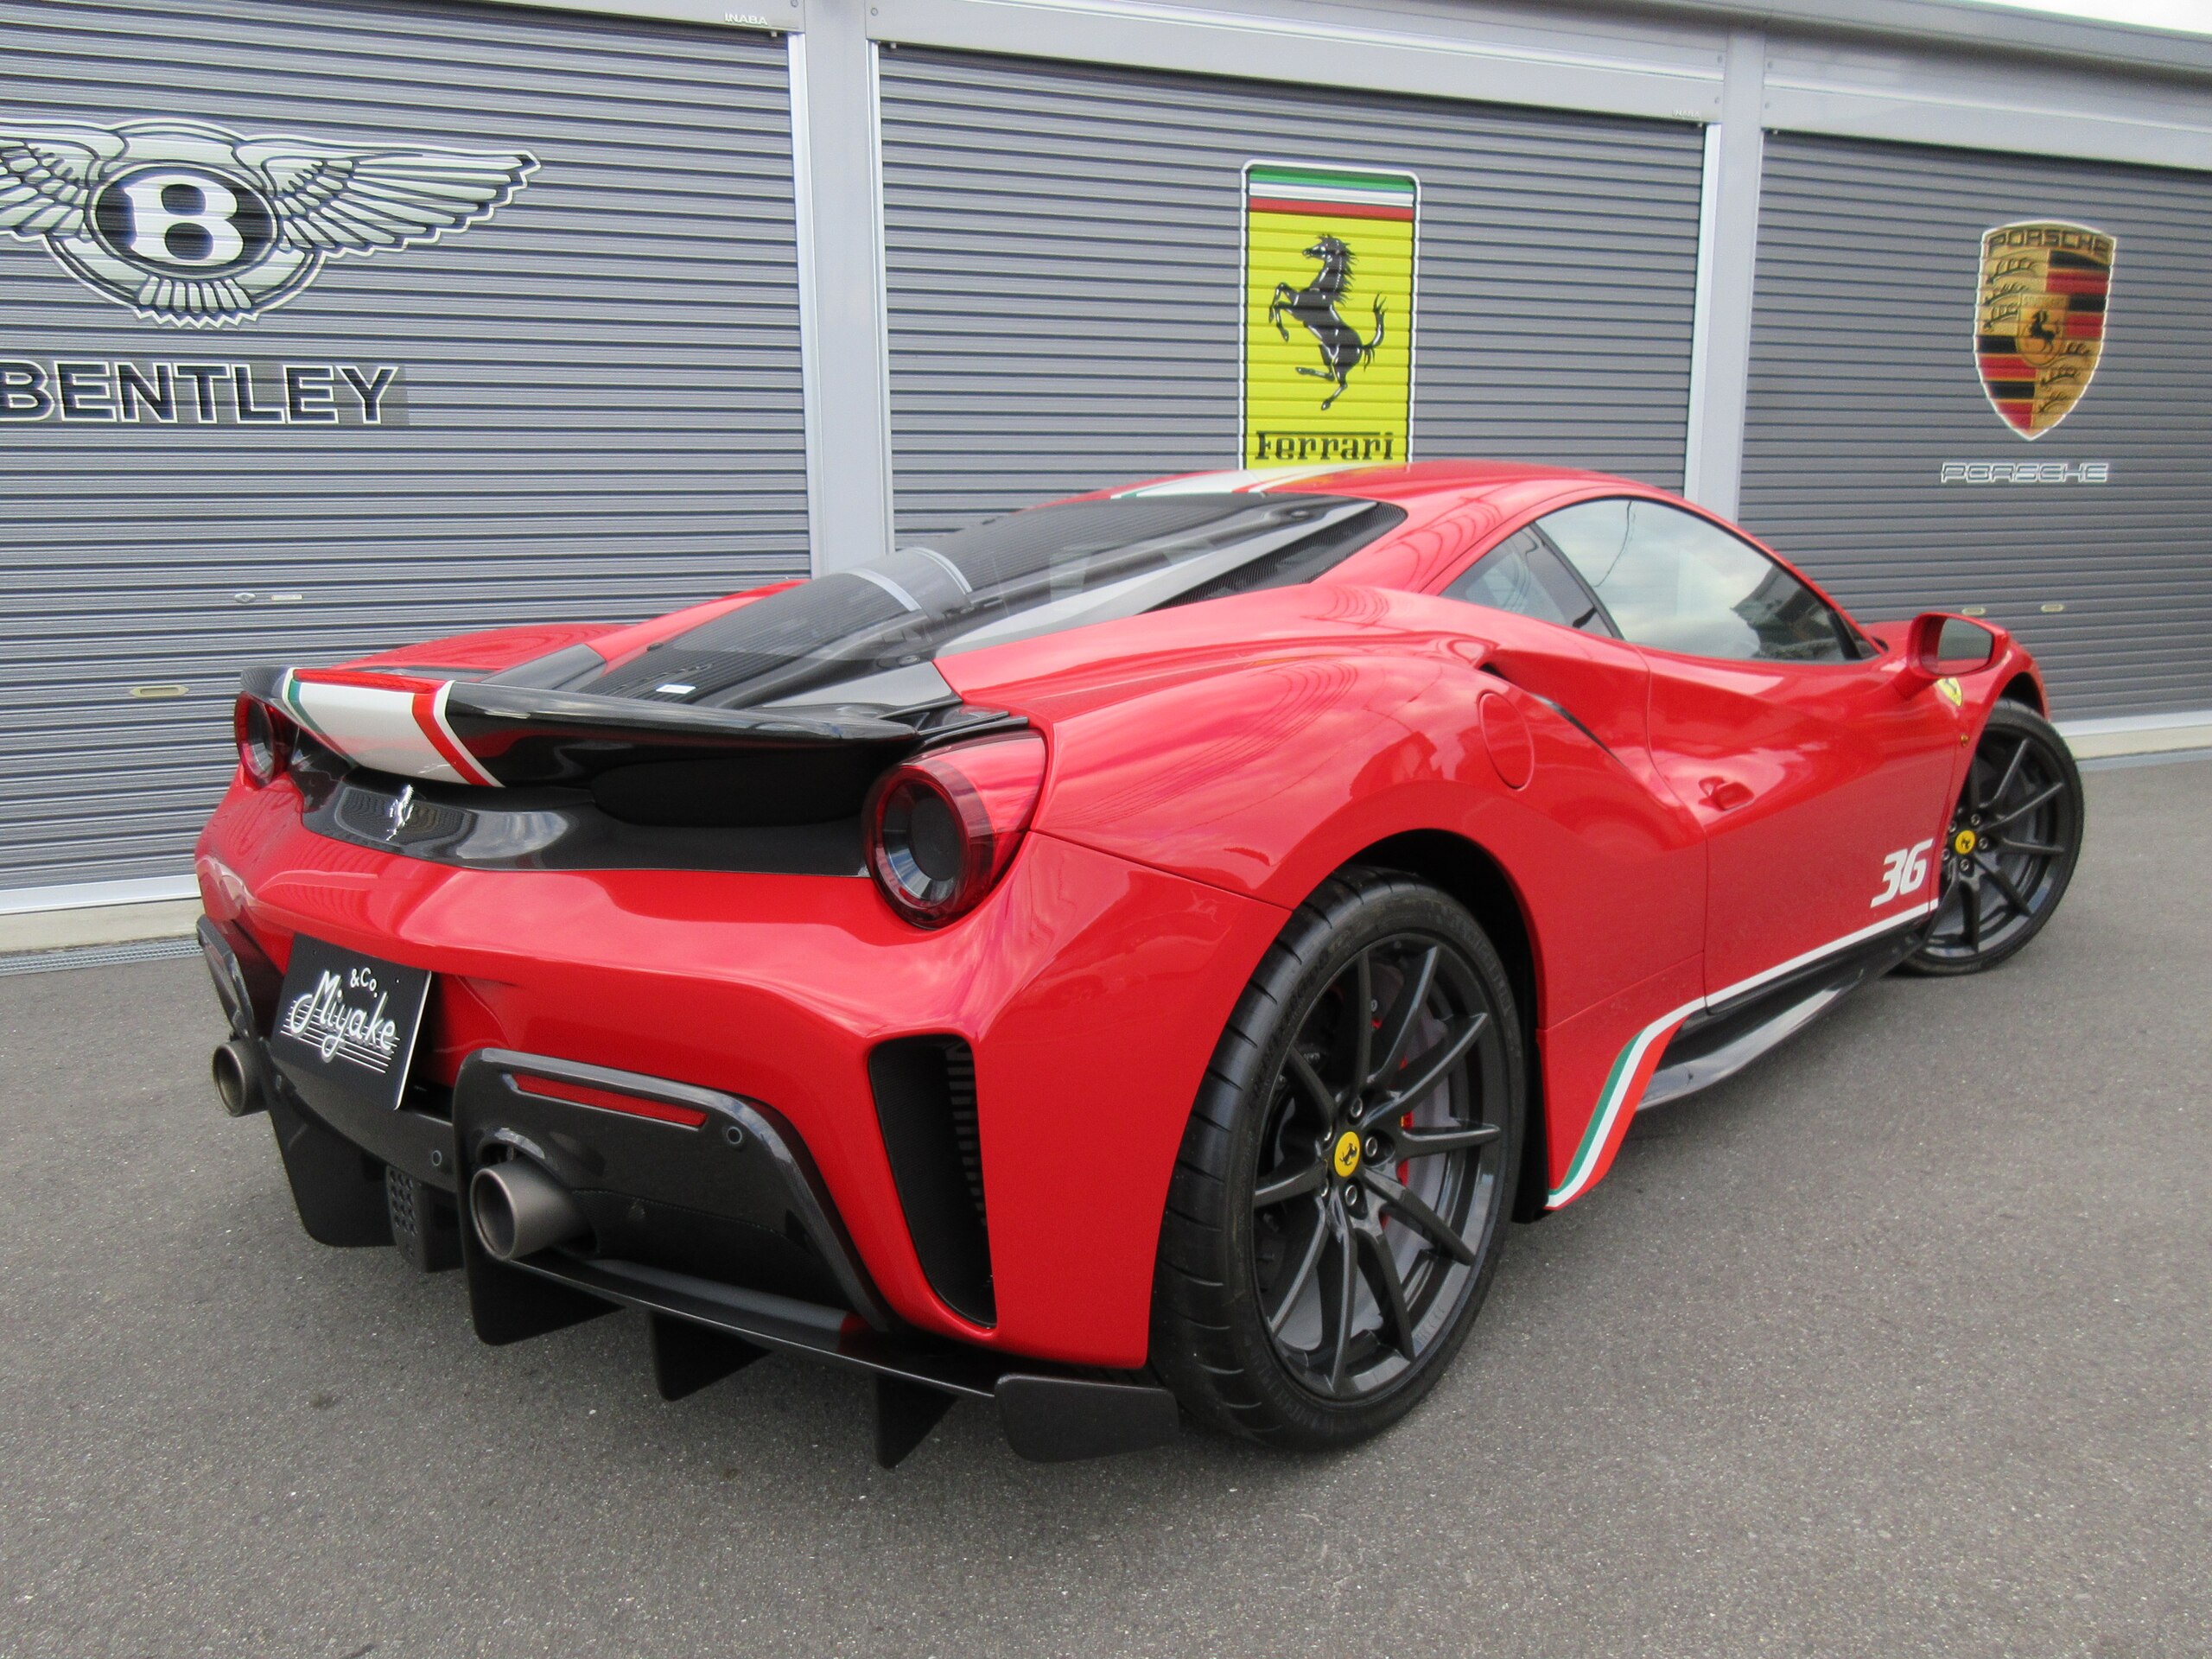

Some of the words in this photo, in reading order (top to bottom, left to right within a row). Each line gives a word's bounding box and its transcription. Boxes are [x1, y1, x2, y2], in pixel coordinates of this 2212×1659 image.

[724, 12, 768, 26] INABA
[124, 175, 244, 267] B
[1988, 229, 2111, 252] PORSCHE
[0, 359, 399, 424] BENTLEY
[1255, 430, 1395, 461] Ferrari
[1941, 462, 2108, 483] PORSCHE
[1870, 837, 1935, 909] 36
[289, 970, 397, 1062] Miyake
